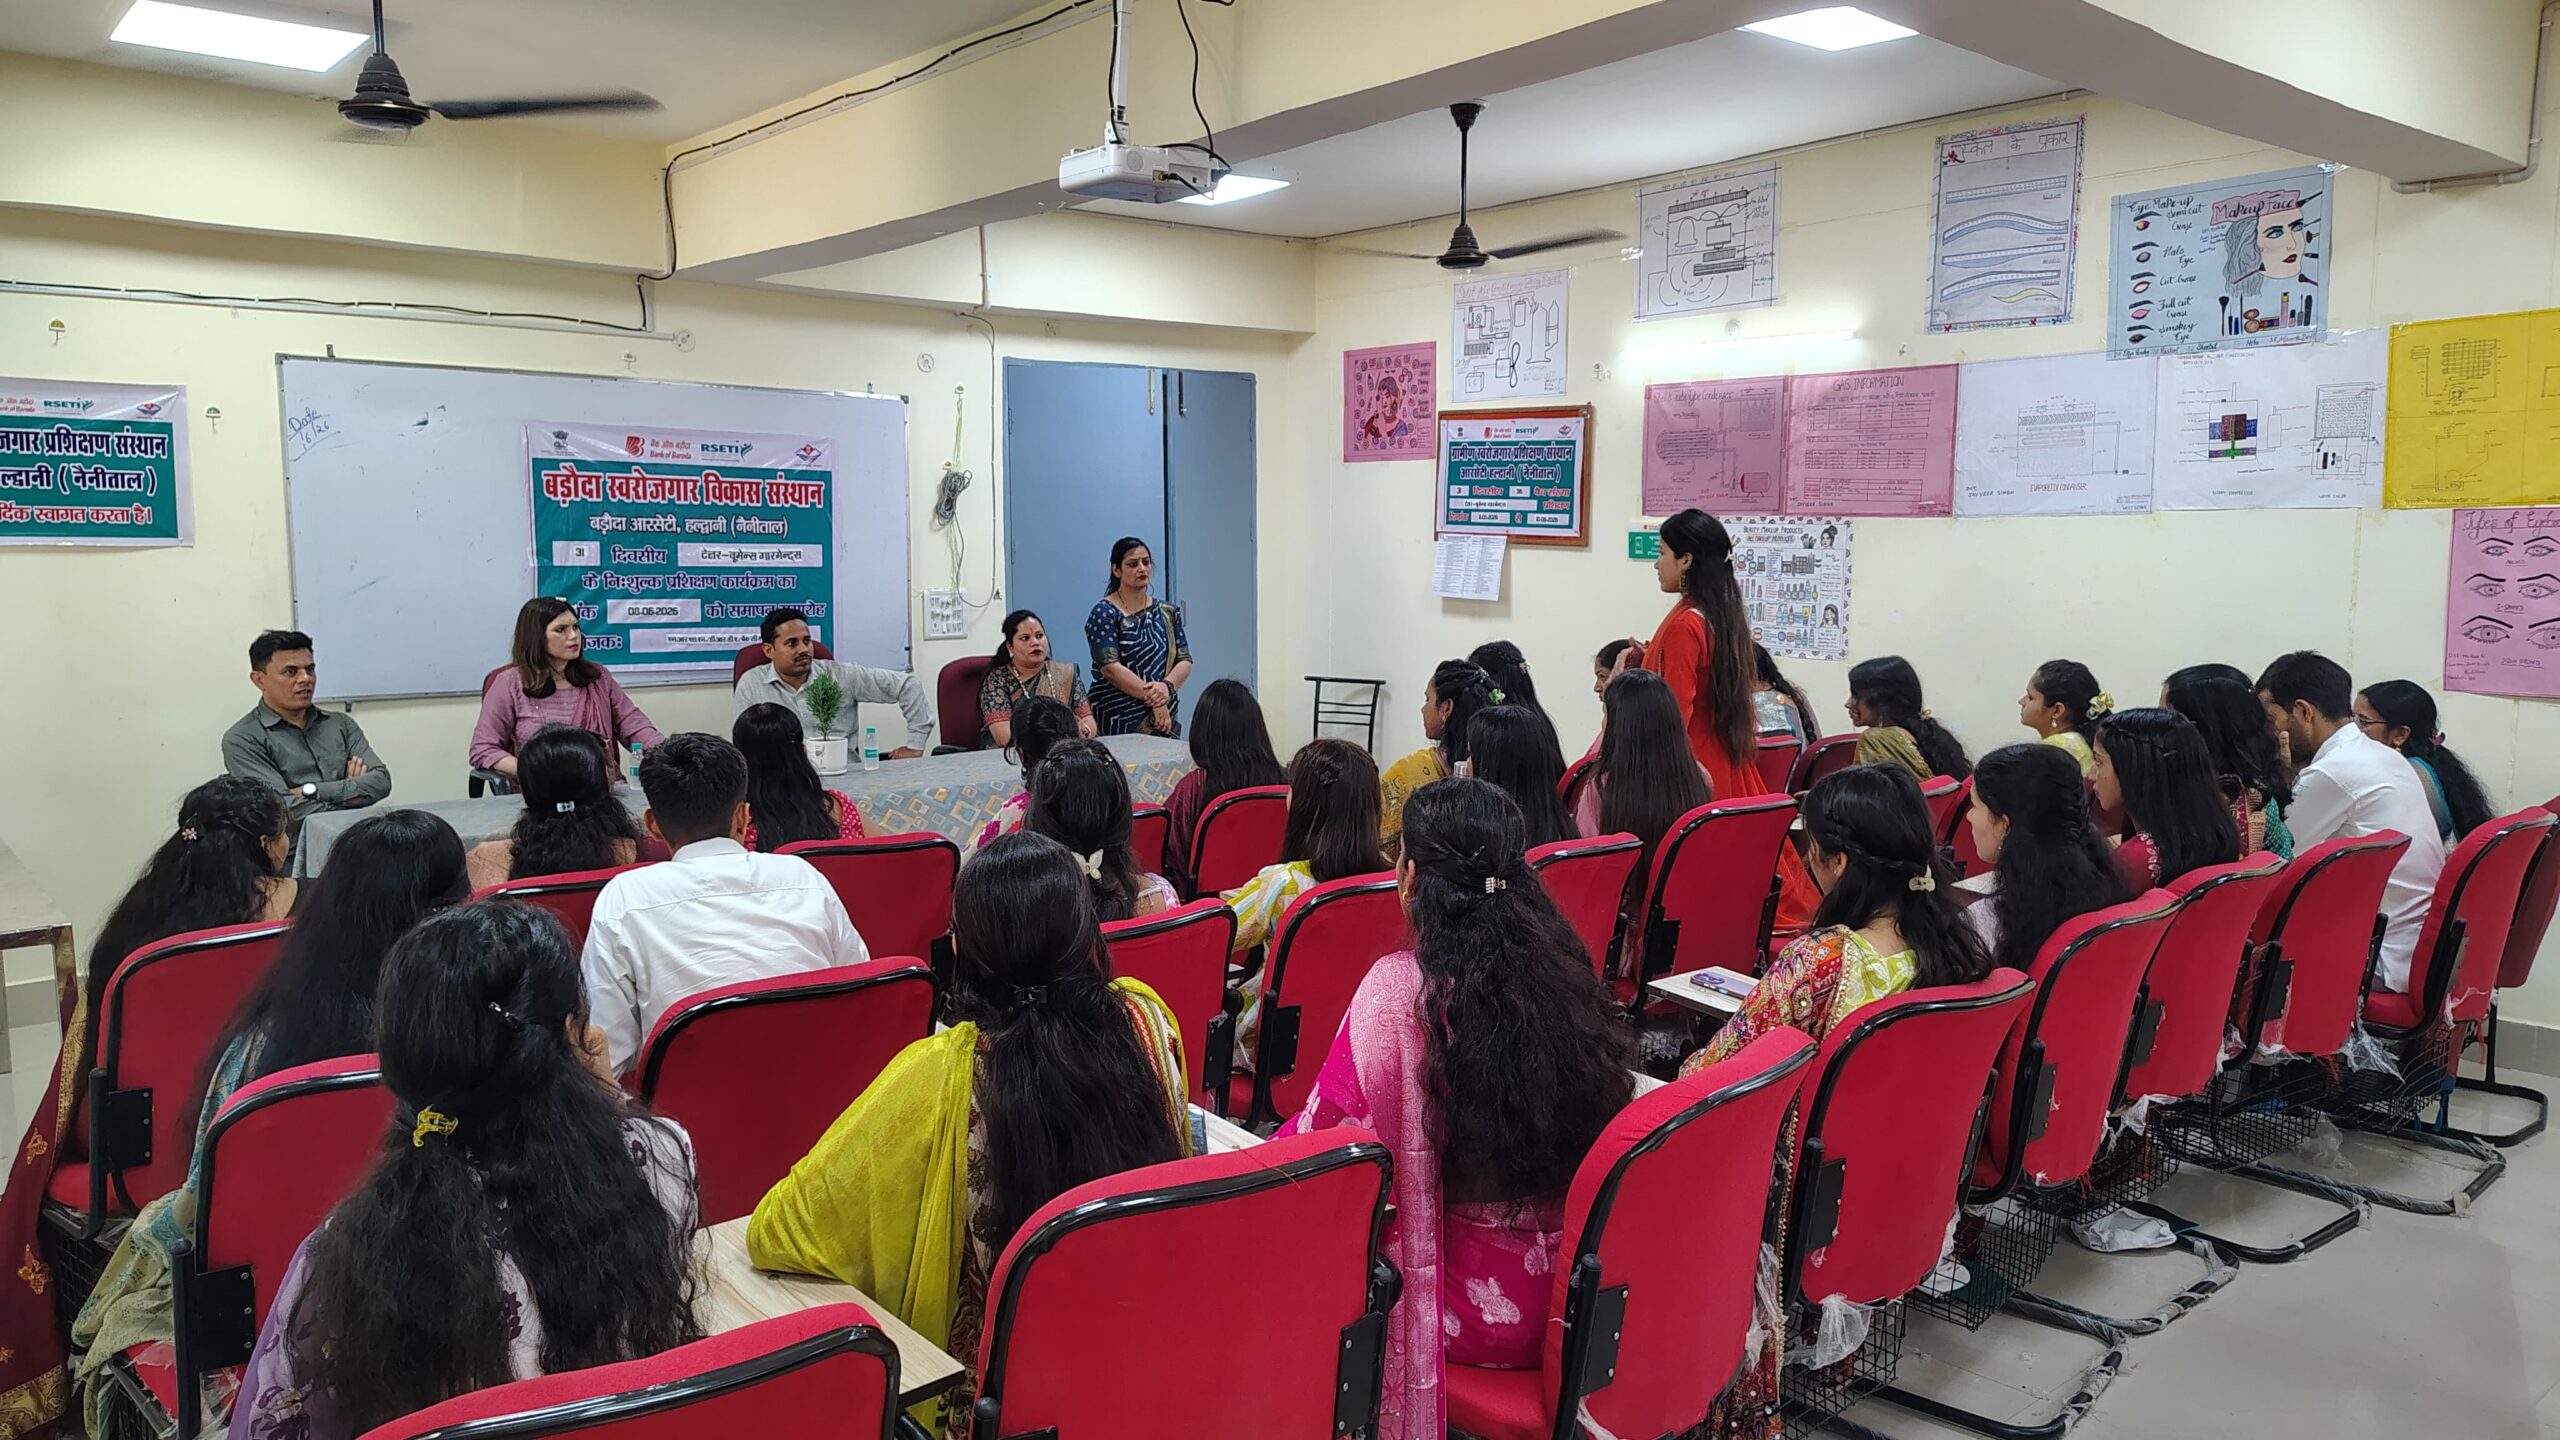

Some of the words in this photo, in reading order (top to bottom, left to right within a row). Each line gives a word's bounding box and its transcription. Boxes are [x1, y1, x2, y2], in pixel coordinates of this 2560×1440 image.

[2010, 135, 2024, 151] के
[1833, 379, 1850, 391] GAS
[1853, 375, 1905, 390] INFORMATION
[45, 425, 111, 457] प्रशिक्षण
[115, 426, 167, 457] संस्थान
[1514, 442, 1544, 460] प्रशिक्षण
[1546, 441, 1573, 459] संस्थान
[543, 464, 603, 506] बड़ौदा
[607, 467, 700, 503] स्वरोजगार
[703, 471, 762, 504] विकास
[766, 473, 824, 507] संस्थान
[35, 506, 86, 523] स्वागत
[90, 507, 131, 523] करता
[589, 512, 627, 535] बड़ौदा
[685, 514, 727, 535] हल्द्वानी
[731, 514, 788, 538] (नैनीताल)
[612, 545, 667, 563] दिवसीय
[583, 572, 599, 588] के
[666, 571, 717, 590] प्रशिक्षण
[721, 571, 775, 590] कार्यक्रम
[777, 575, 796, 589] का
[705, 602, 726, 618] को
